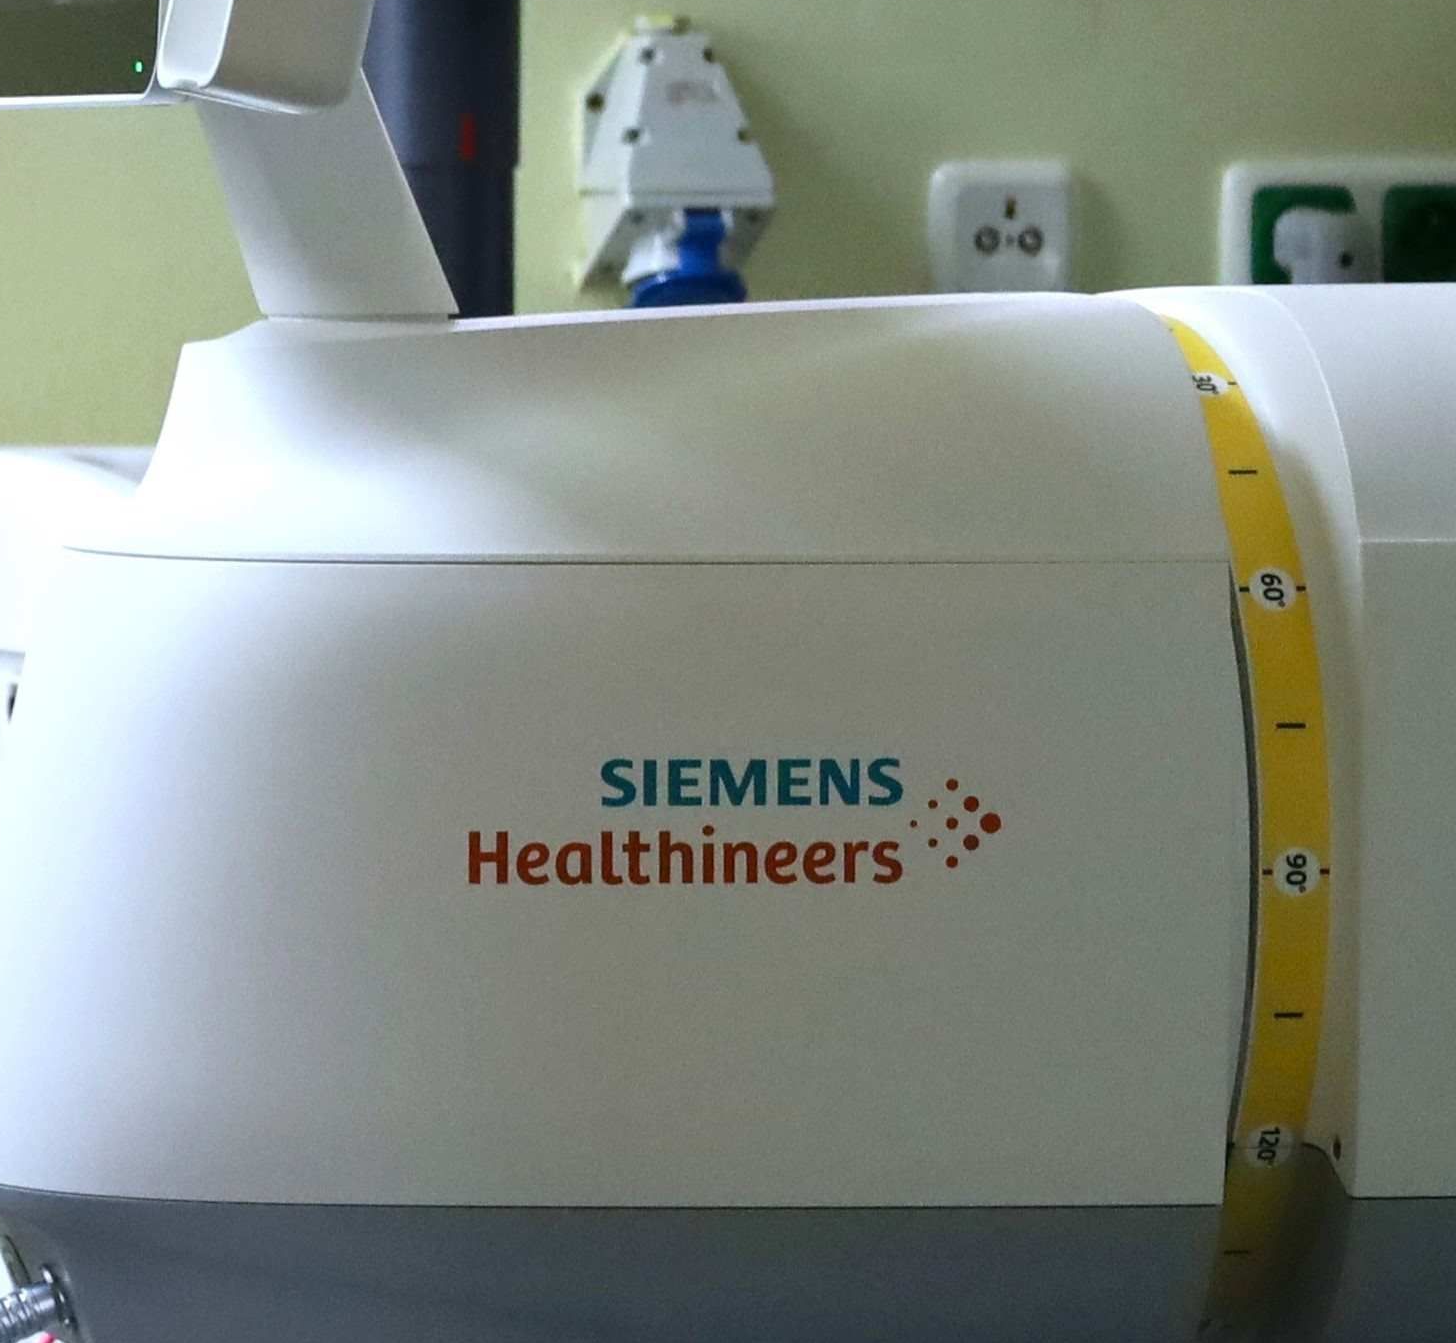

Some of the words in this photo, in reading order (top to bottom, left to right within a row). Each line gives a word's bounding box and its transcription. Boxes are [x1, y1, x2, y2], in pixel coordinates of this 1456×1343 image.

[1260, 572, 1286, 608] 60°
[599, 756, 905, 809] SIEMENS
[467, 824, 906, 887] Healthineers
[1285, 852, 1308, 894] 90°
